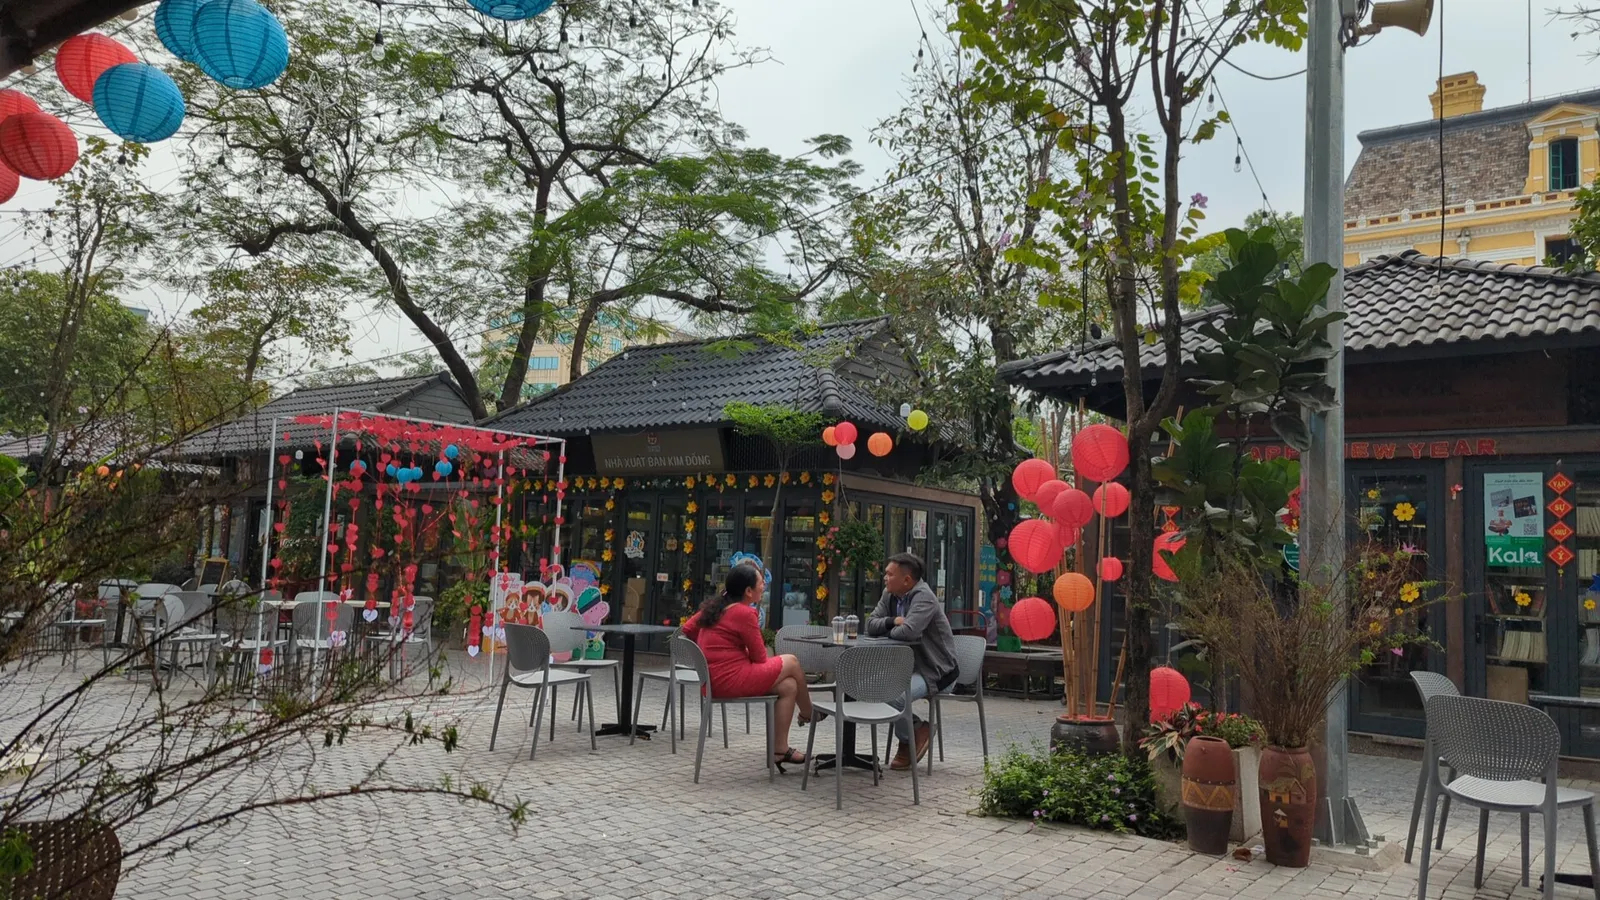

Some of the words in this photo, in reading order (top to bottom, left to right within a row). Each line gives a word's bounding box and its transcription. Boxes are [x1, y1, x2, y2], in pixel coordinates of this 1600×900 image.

[1344, 442, 1396, 460] EW
[1408, 439, 1497, 459] YEAR
[668, 455, 685, 466] KIM
[1489, 547, 1541, 563] Kala
